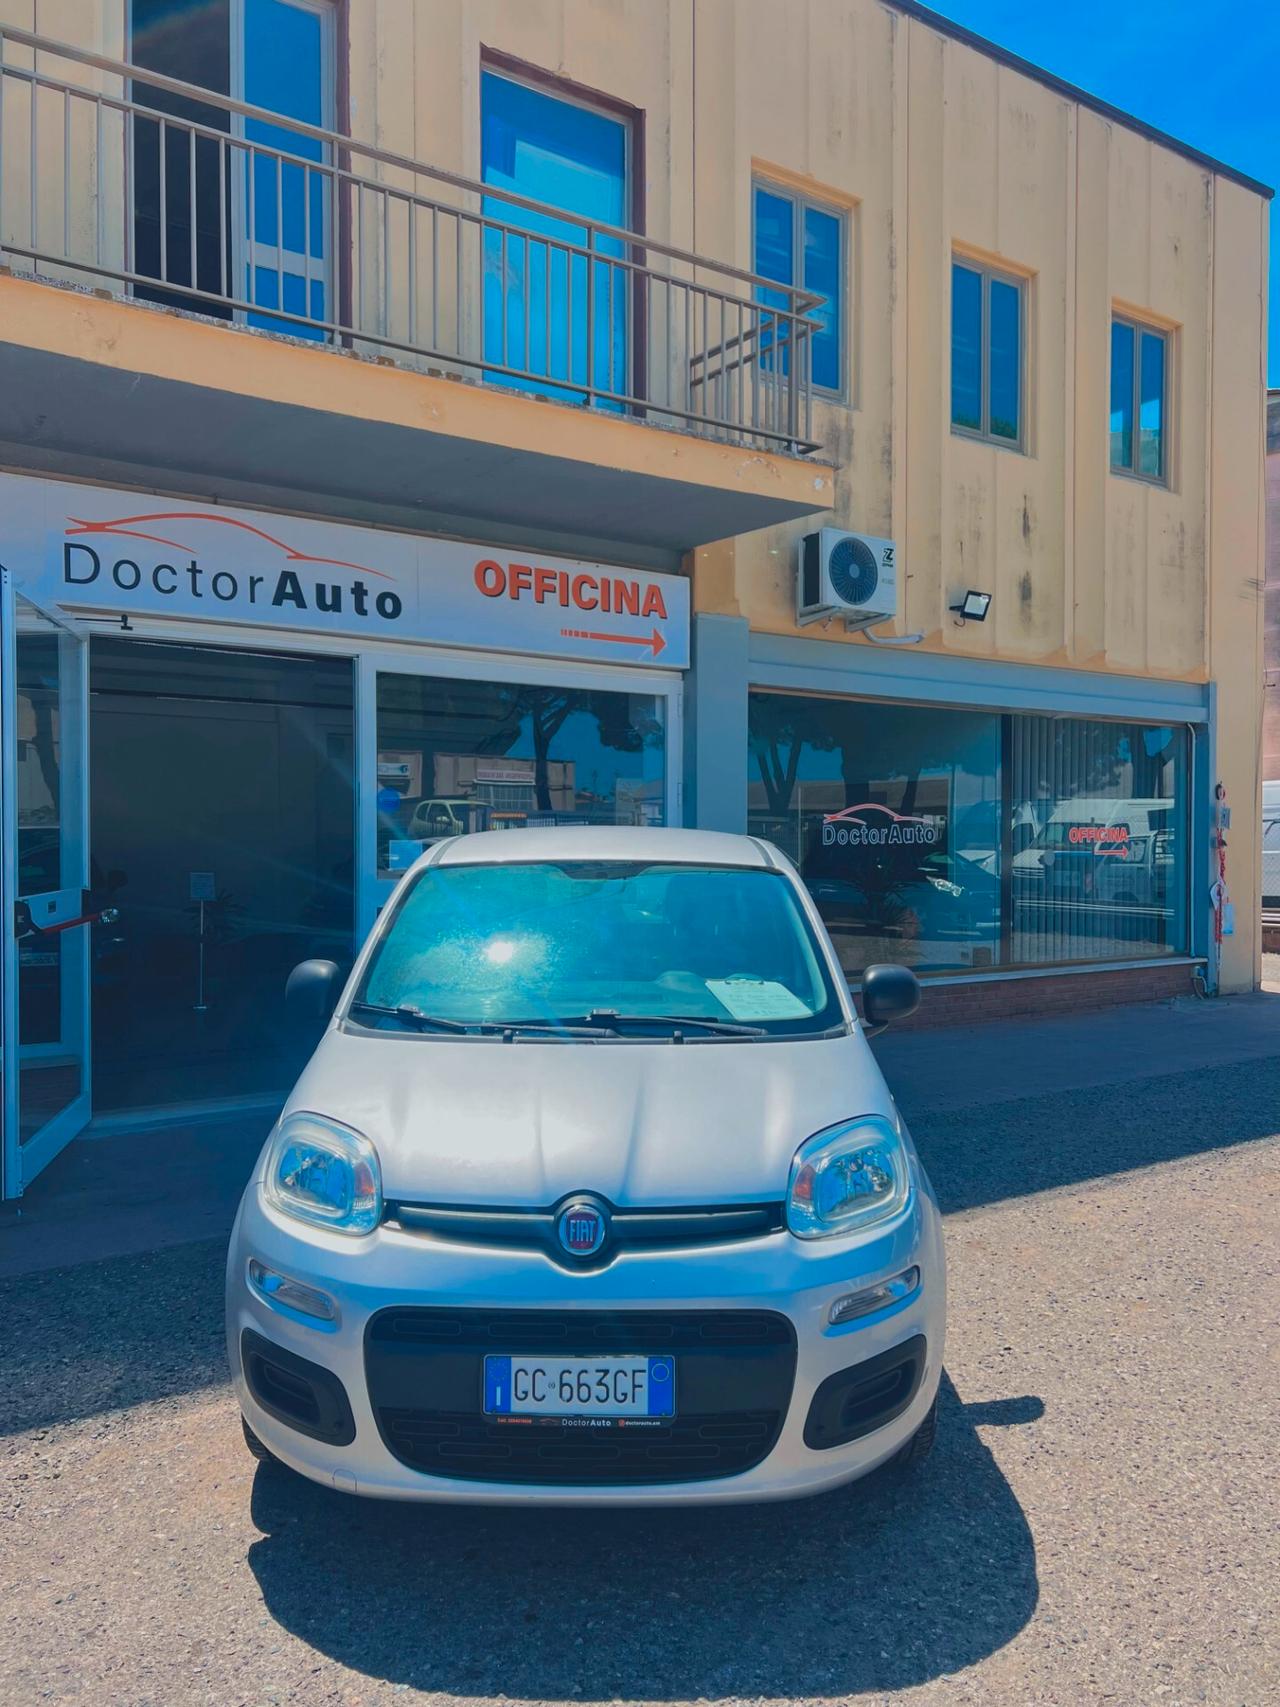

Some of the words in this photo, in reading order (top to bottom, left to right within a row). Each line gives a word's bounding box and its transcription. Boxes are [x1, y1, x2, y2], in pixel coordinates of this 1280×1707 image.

[64, 542, 403, 621] DoctorAuto
[473, 558, 669, 621] OFFICINA
[822, 824, 936, 846] DoctorAuto
[1069, 826, 1129, 844] OFFICINA
[569, 1219, 597, 1242] FIAT
[513, 1368, 547, 1402] GC
[558, 1369, 648, 1404] 663GF
[561, 1417, 612, 1427] DoctorAuto
